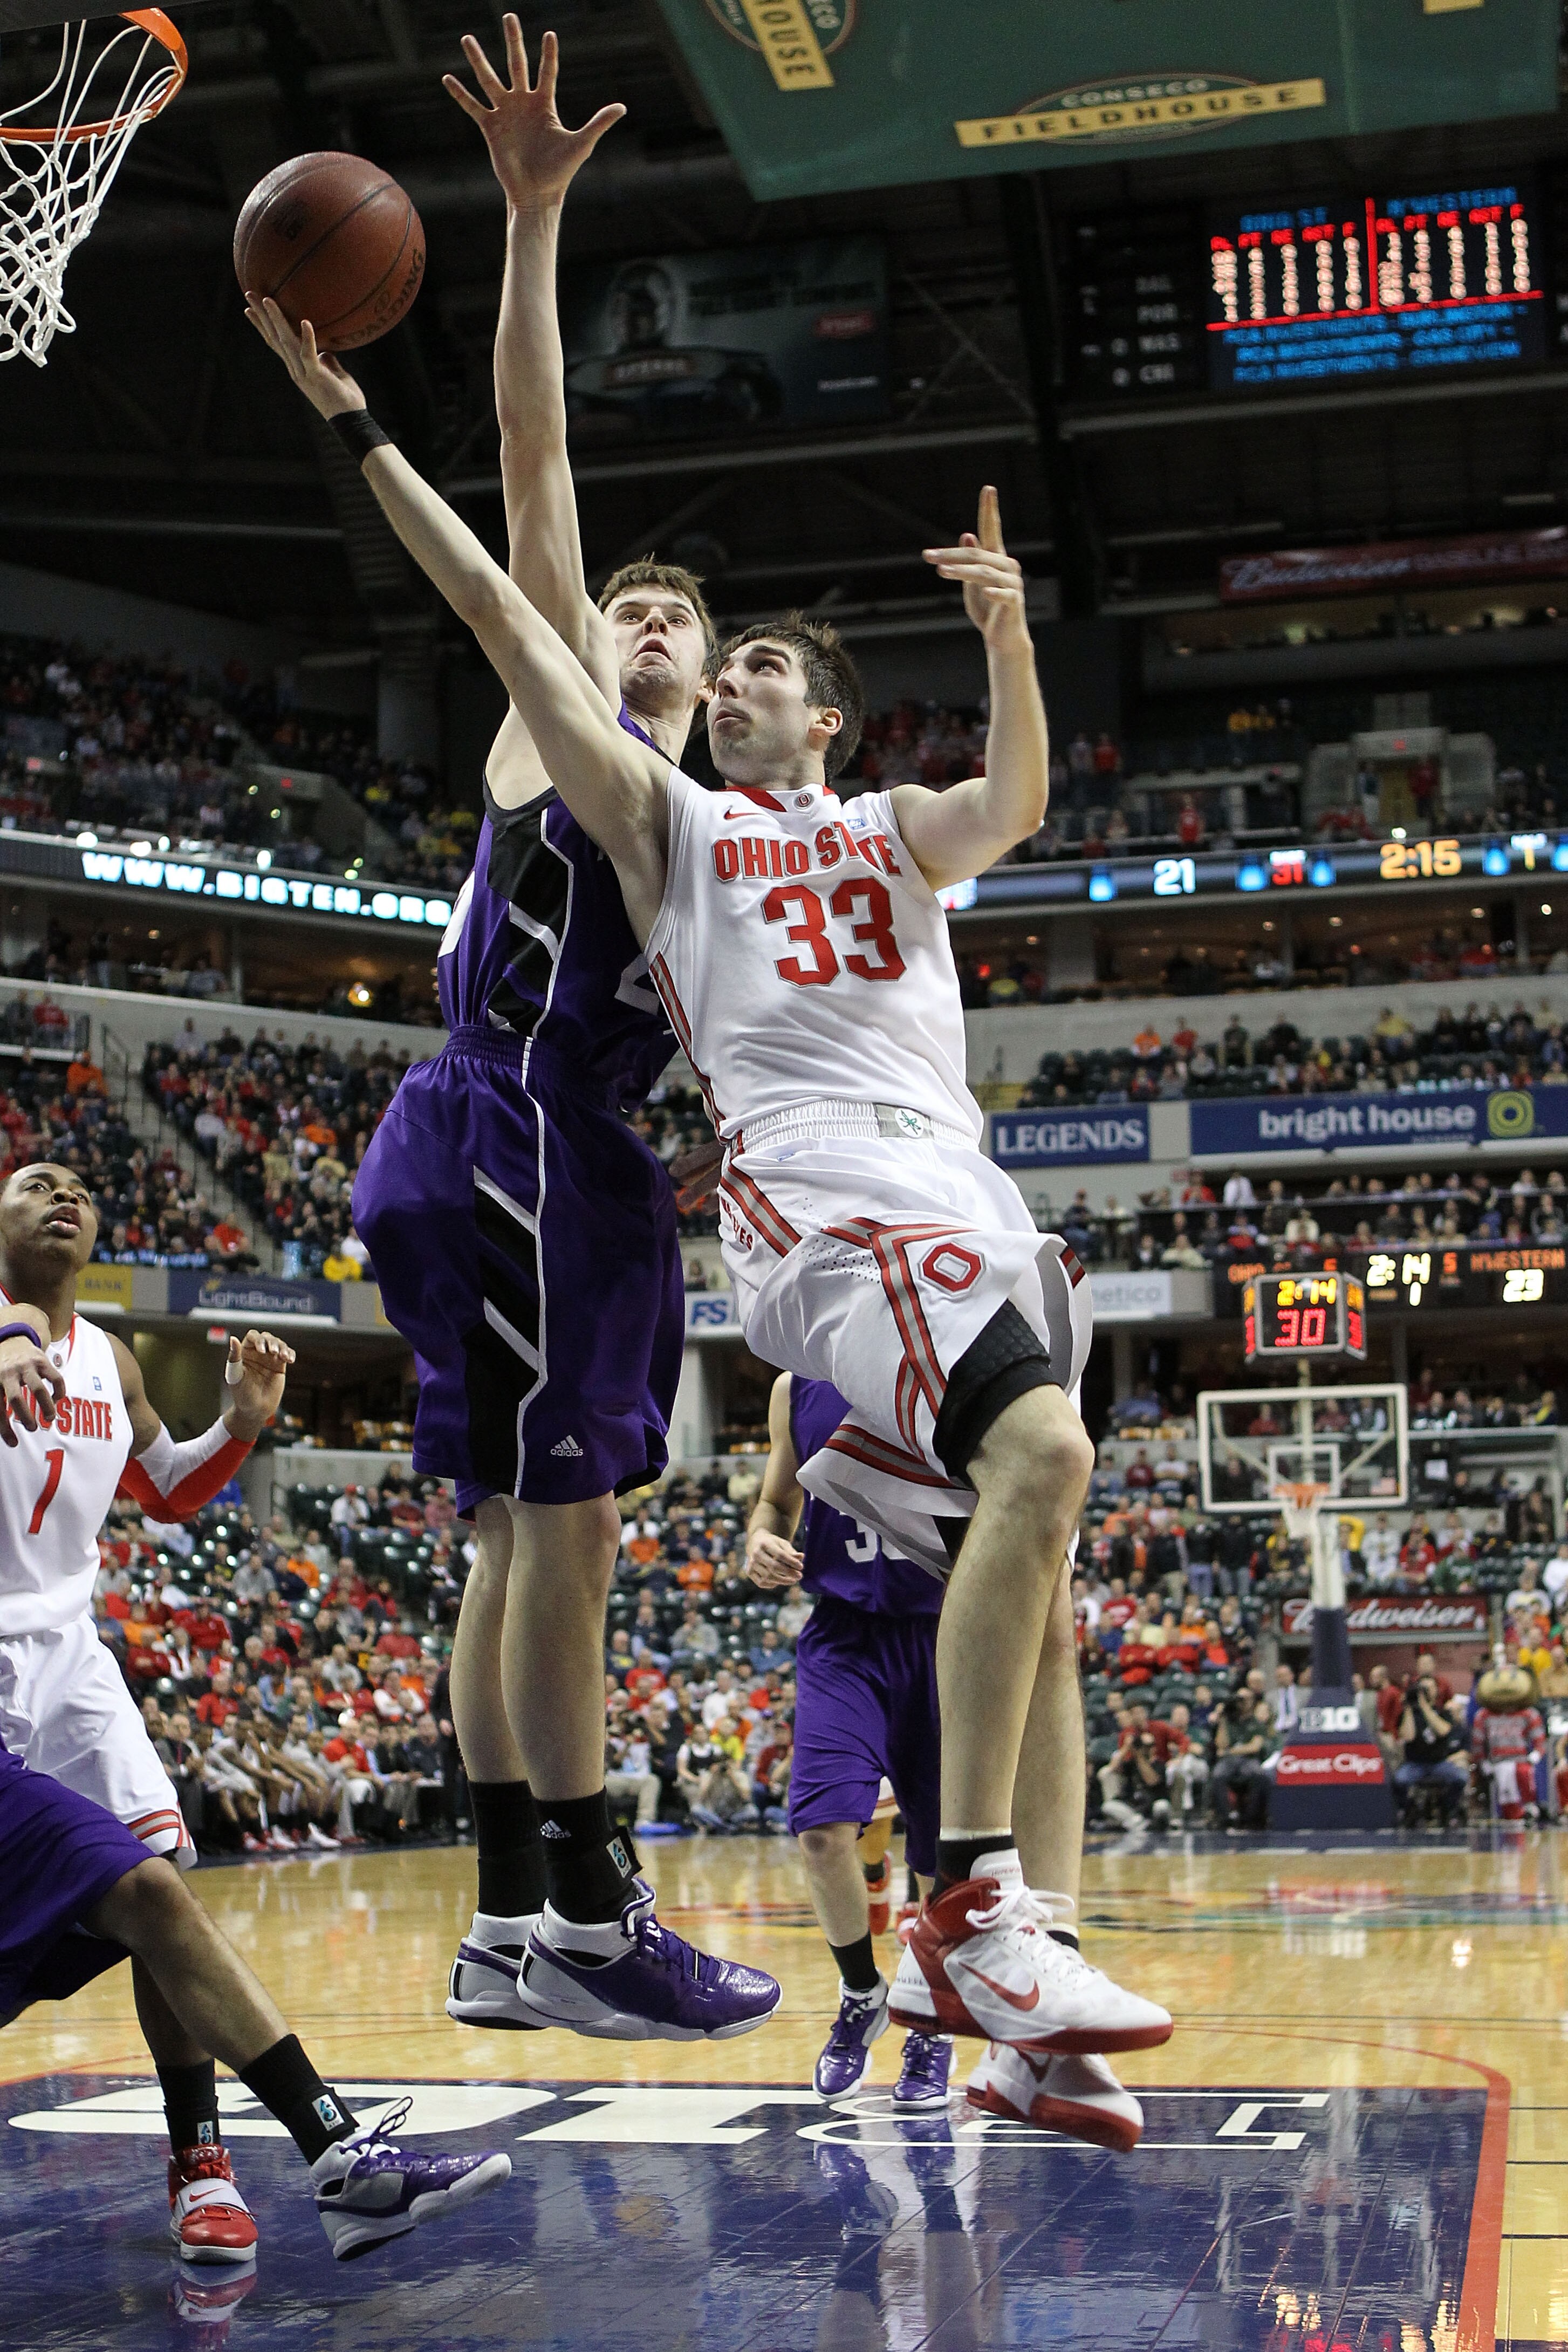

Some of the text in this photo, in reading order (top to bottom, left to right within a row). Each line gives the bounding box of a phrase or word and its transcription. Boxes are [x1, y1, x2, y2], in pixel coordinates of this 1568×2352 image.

[1061, 79, 1208, 108] CONSECO
[982, 87, 1298, 139] FIELDHOUSE
[712, 837, 811, 883] OHIO
[1153, 858, 1196, 895] 21
[1380, 839, 1462, 880] 2:15
[761, 876, 908, 988] 33
[997, 1118, 1146, 1155] LEGENDS
[1259, 1104, 1476, 1143] bright house
[917, 1242, 986, 1296] O
[1367, 1253, 1431, 1287] 2:14
[1503, 1268, 1544, 1302] 23
[198, 1286, 312, 1313] LightBound
[1277, 1277, 1337, 1306] 2:14
[1275, 1308, 1326, 1346] 30
[55, 1396, 113, 1441] STATE
[550, 1448, 584, 1457] adidas
[29, 1448, 64, 1534] 1
[1276, 1753, 1383, 1777] Great Clips
